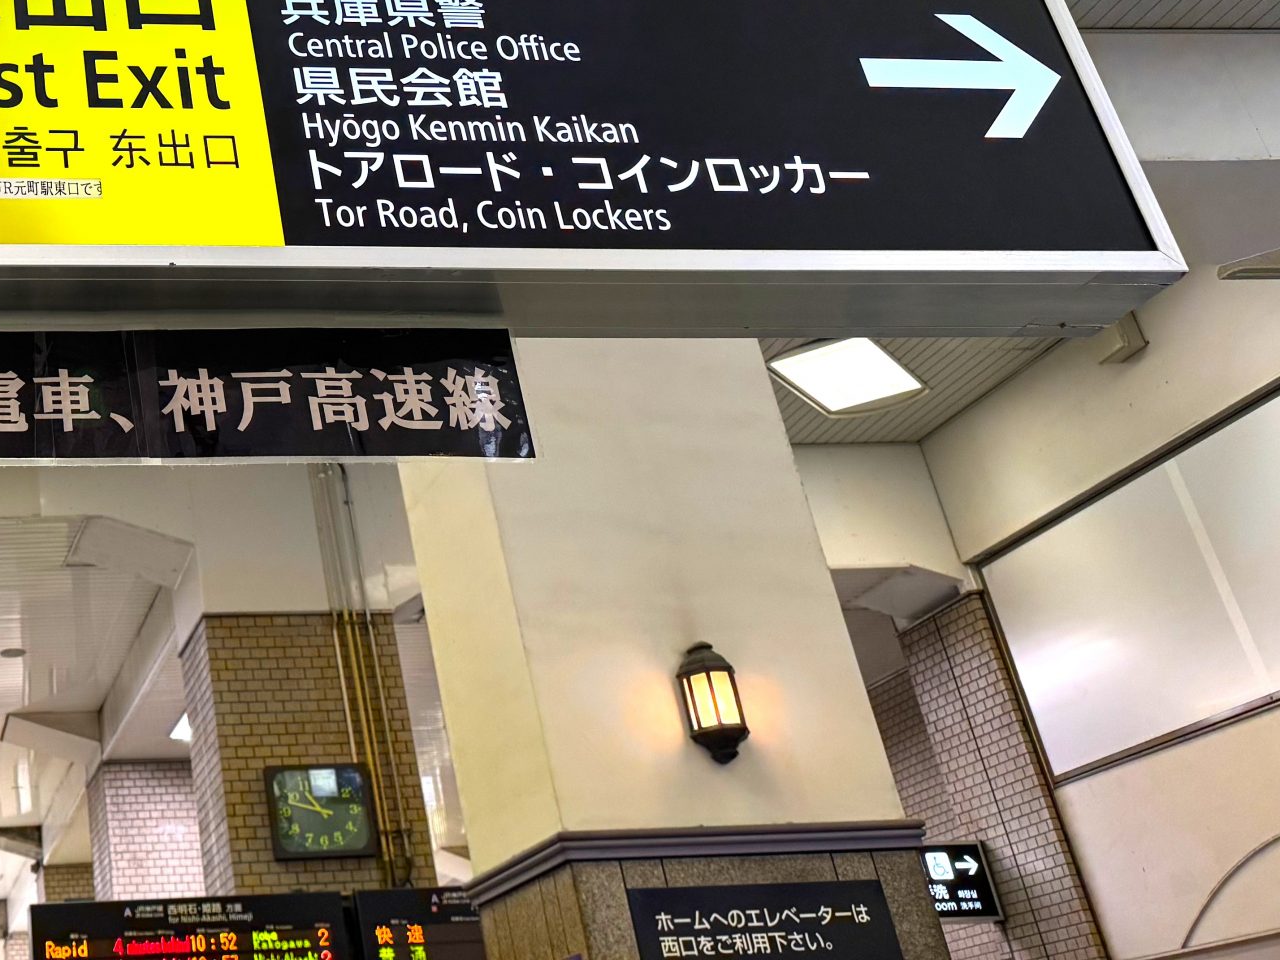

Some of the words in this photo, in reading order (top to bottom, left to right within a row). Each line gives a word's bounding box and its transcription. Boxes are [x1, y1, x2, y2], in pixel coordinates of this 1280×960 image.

[289, 32, 393, 58] Central
[401, 33, 487, 60] Police
[497, 34, 580, 61] Office
[83, 49, 230, 109] Exit
[293, 67, 508, 108] 県民会館
[302, 113, 399, 147] Hyōgo
[409, 114, 526, 141] Kenmin
[533, 115, 639, 143] Kaikan
[3, 127, 84, 168] 출구
[110, 129, 239, 168] 东出口
[309, 150, 869, 194] トアロード・コインロッカー
[315, 199, 367, 227] Tor
[377, 198, 467, 233] Road,
[477, 201, 546, 229] Coin
[554, 200, 671, 230] Lockers
[656, 904, 870, 931] ホームへのエレベーターは
[45, 939, 89, 959] Rapid
[113, 937, 124, 956] 4
[317, 928, 331, 946] 2
[659, 932, 832, 957] 西口をご利用下さい。
